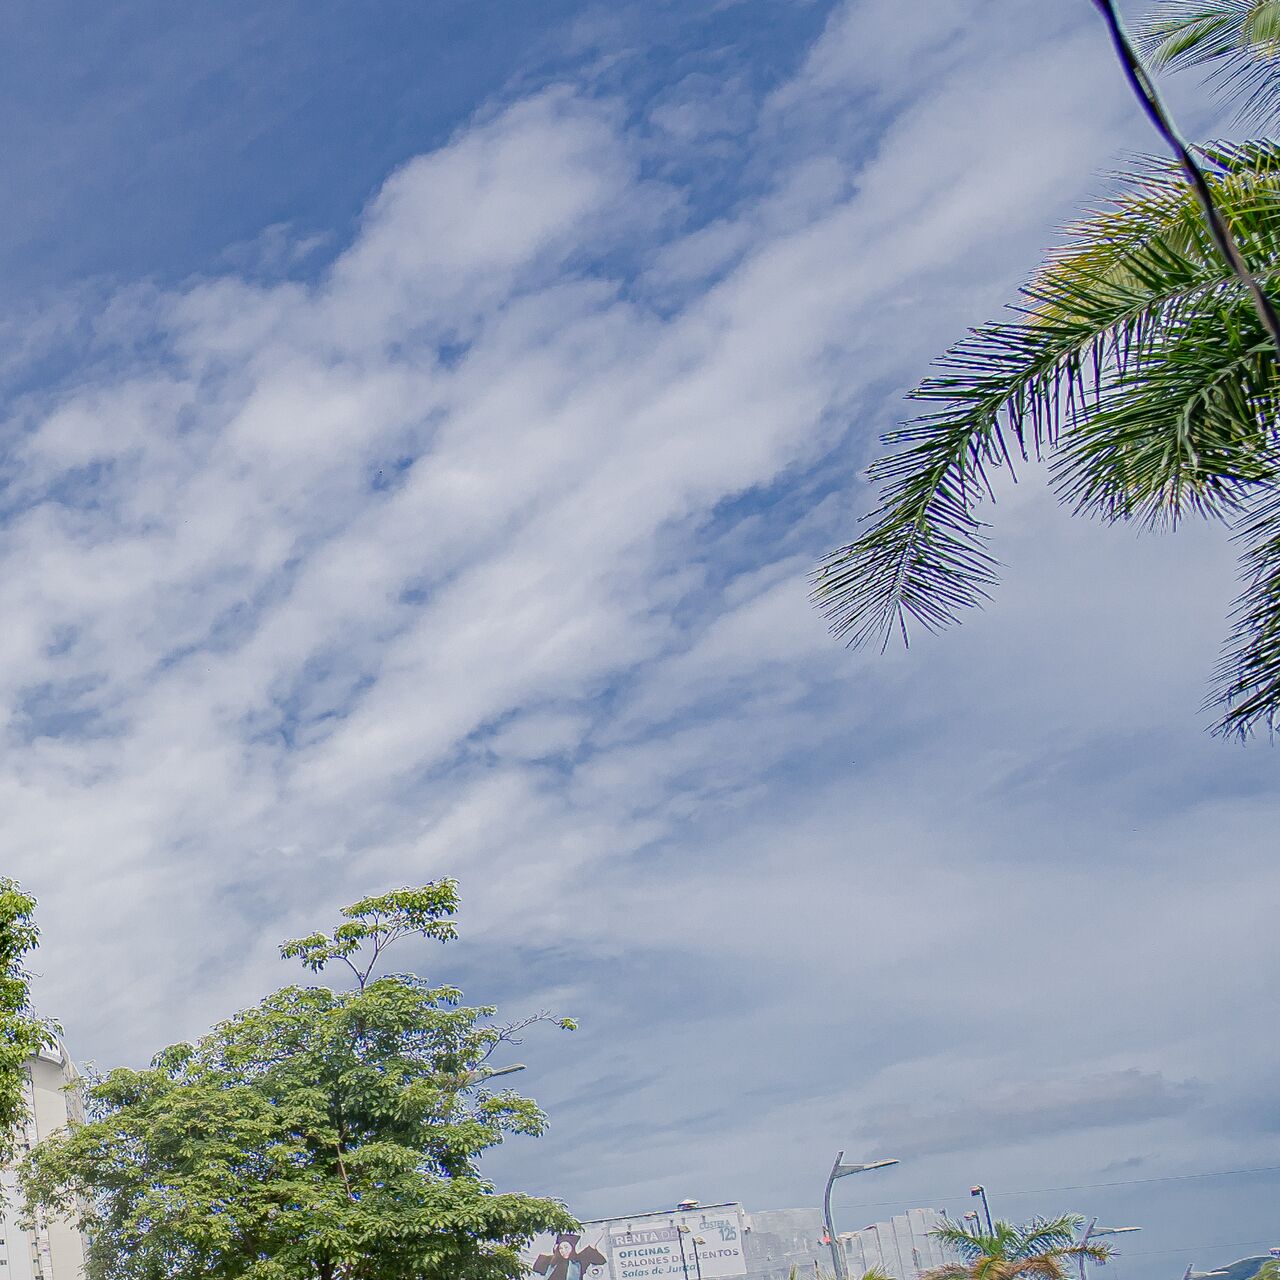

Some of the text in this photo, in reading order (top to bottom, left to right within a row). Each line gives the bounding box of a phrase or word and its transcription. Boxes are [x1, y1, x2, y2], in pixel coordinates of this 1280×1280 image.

[615, 1231, 659, 1246] RENTA
[719, 1227, 737, 1242] 125
[618, 1245, 671, 1259] OFICINAS
[620, 1256, 670, 1269] SALONES
[621, 1268, 649, 1279] Salas
[652, 1266, 664, 1277] de
